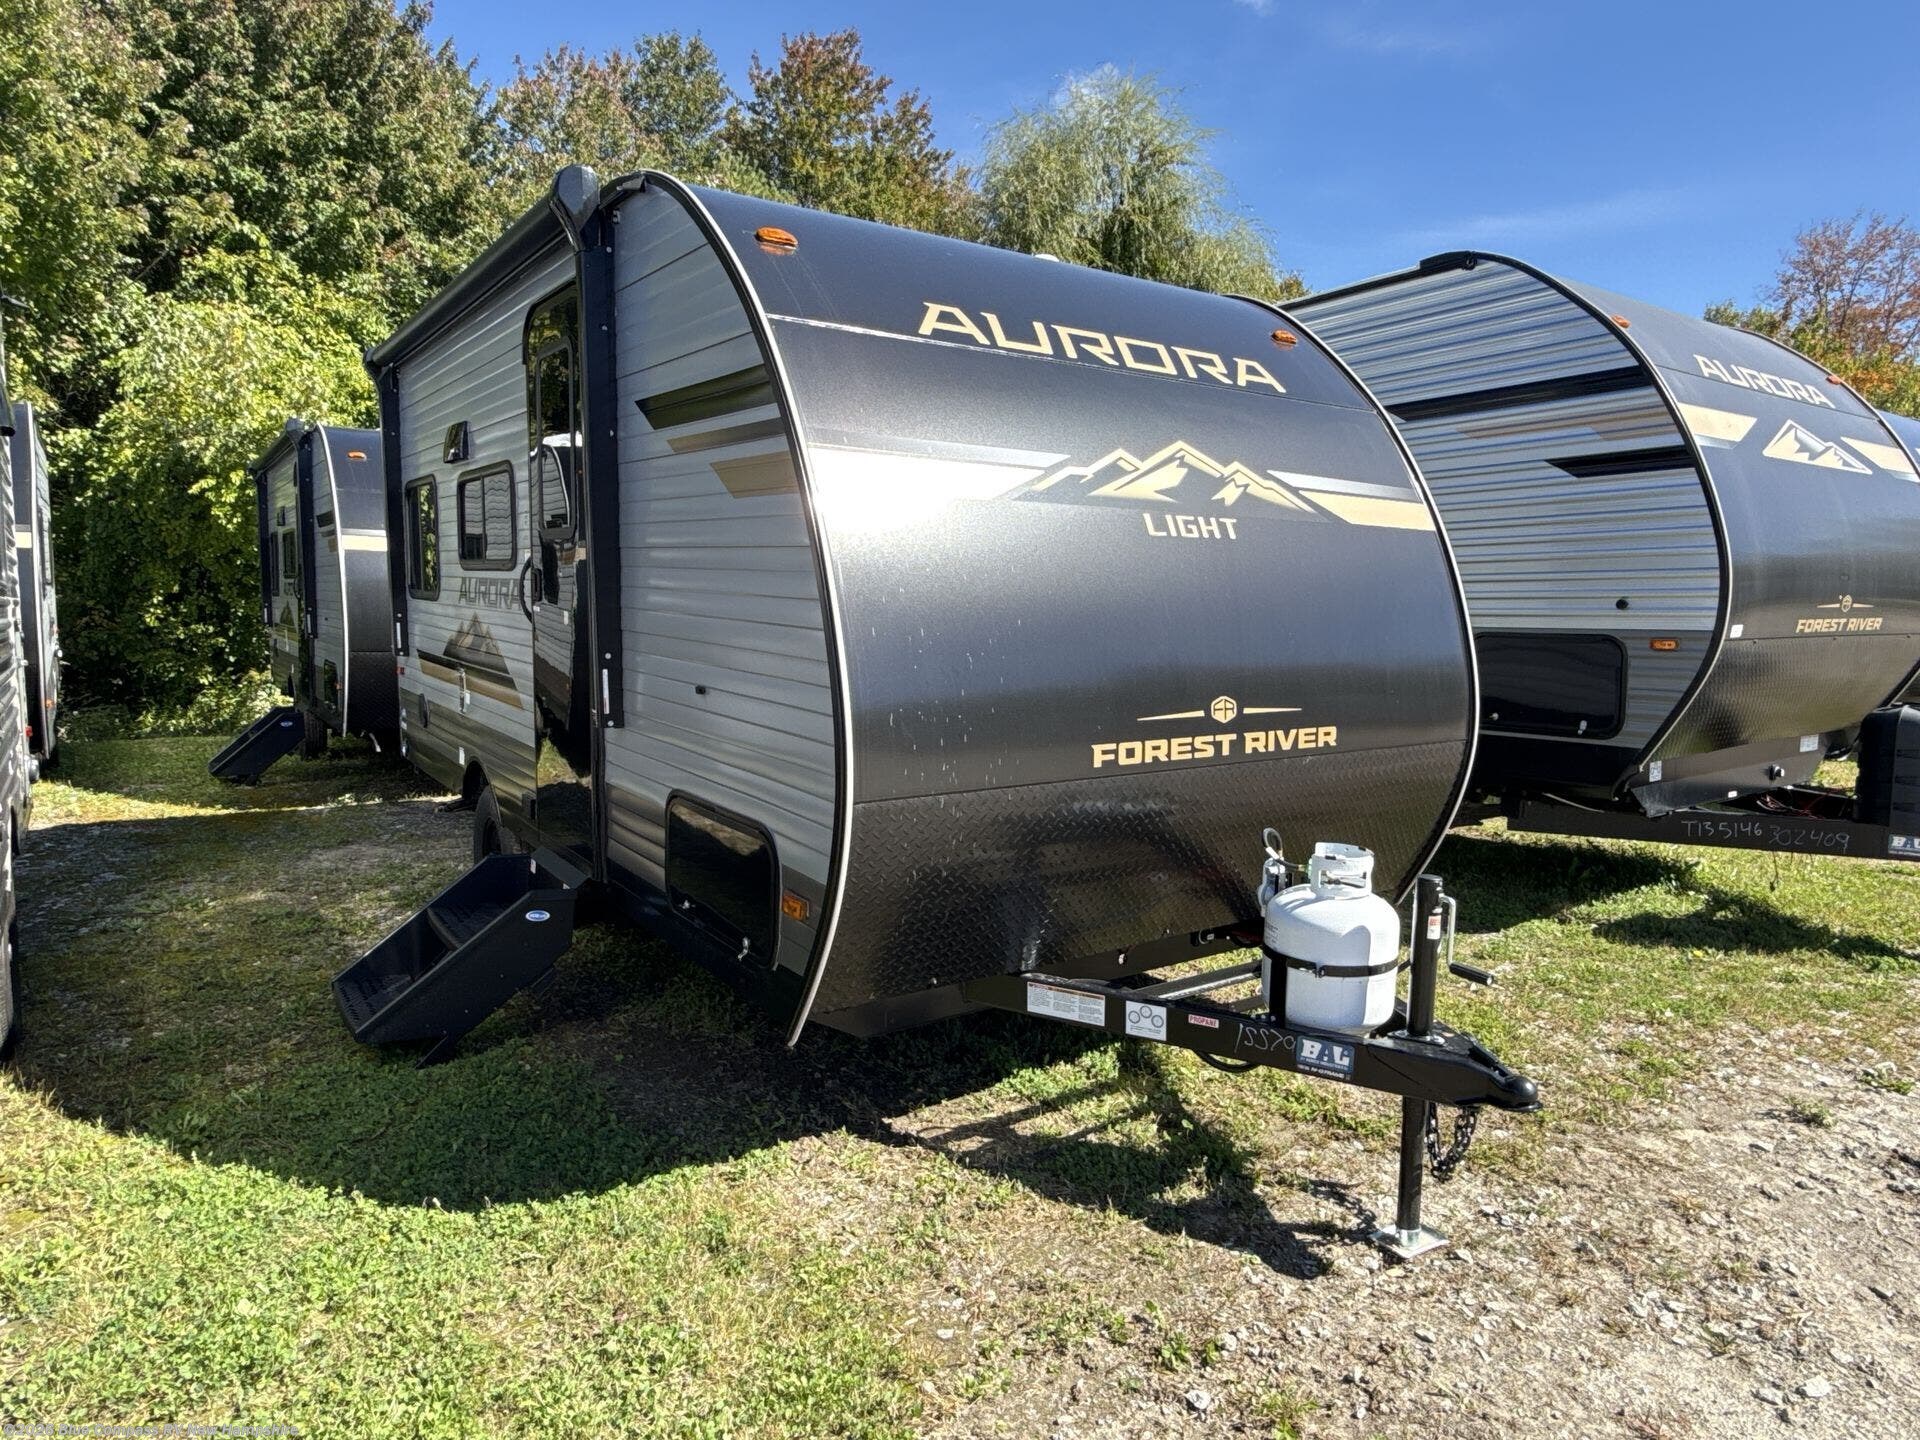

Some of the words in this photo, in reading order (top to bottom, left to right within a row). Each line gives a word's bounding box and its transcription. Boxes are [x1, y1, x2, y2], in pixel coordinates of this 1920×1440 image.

[918, 302, 1287, 393] AURORA
[1693, 354, 1836, 409] AURORA
[1142, 513, 1237, 540] LIGHT
[458, 577, 523, 611] AURORA
[1795, 618, 1846, 633] FOREST
[1846, 617, 1883, 631] RIVER
[1091, 733, 1237, 768] FOREST
[1243, 726, 1337, 754] RIVER
[1189, 1014, 1217, 1028] PROPANE
[1301, 1039, 1350, 1066] BAL
